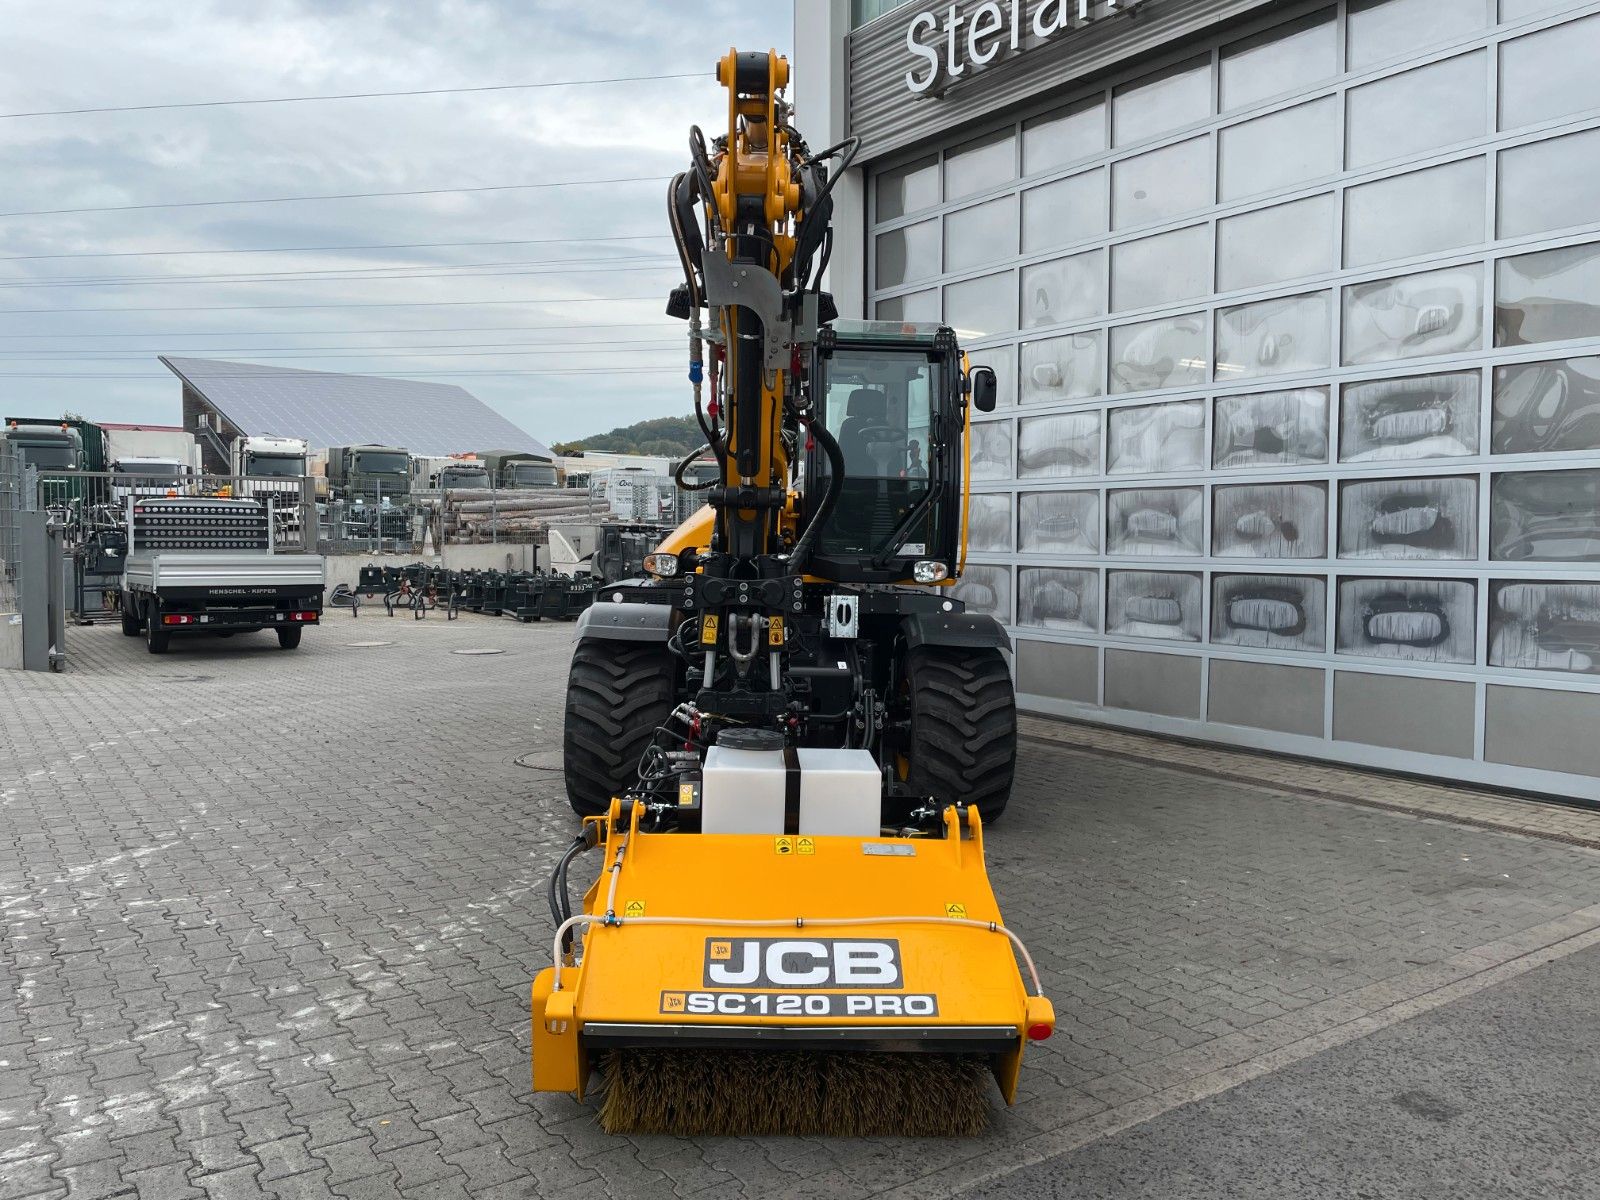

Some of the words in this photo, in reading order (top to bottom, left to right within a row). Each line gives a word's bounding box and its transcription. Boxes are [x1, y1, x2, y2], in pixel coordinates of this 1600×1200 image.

[709, 941, 898, 985] JCB
[687, 993, 831, 1015] SC120
[846, 995, 934, 1015] PRO
